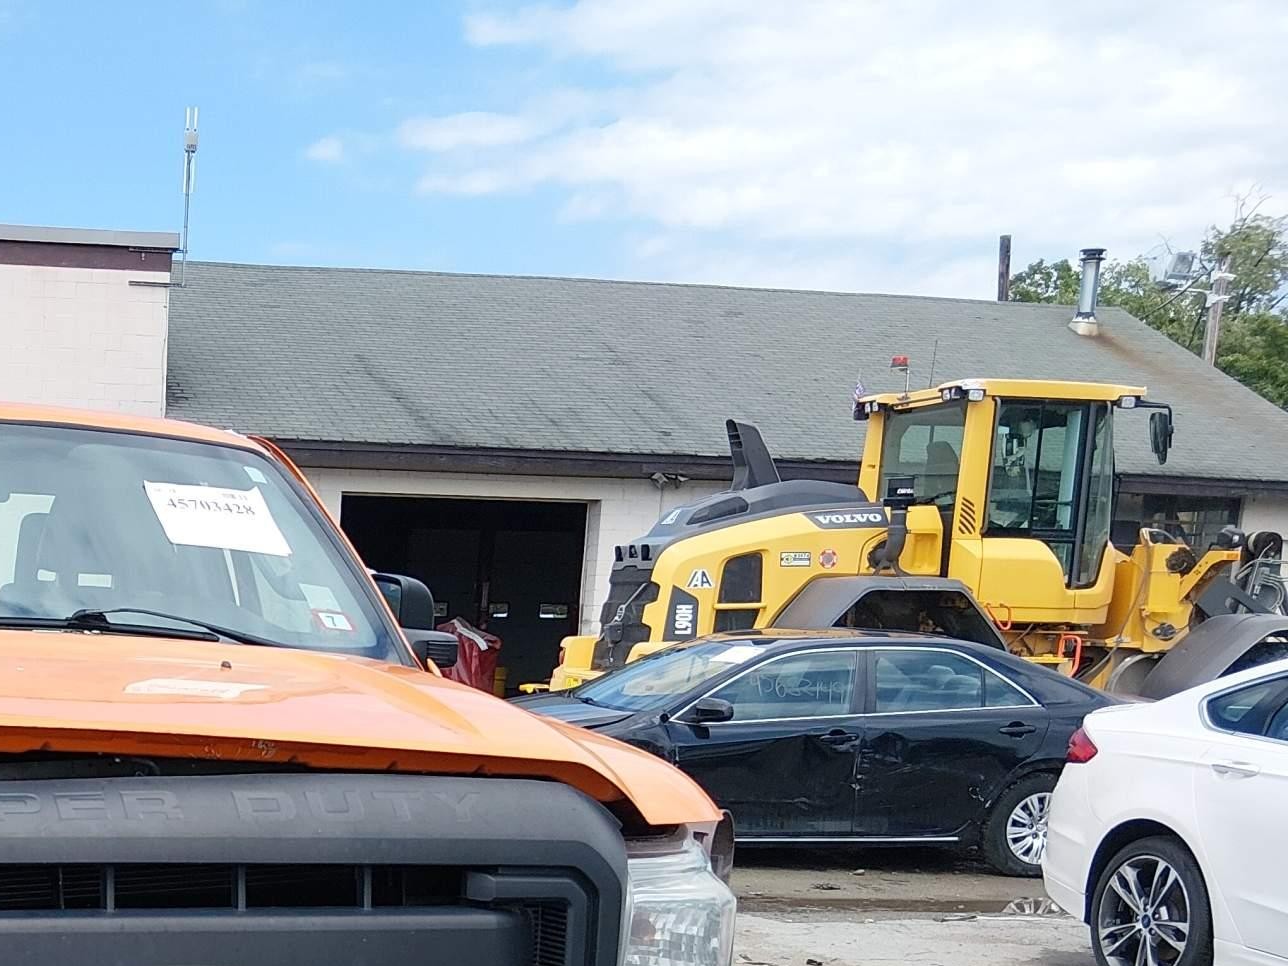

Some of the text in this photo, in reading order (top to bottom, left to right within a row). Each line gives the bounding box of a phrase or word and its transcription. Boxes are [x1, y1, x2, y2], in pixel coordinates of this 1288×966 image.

[167, 497, 256, 516] 45703428
[815, 511, 883, 525] VOLVO
[324, 615, 337, 627] 7
[674, 604, 694, 635] L90H
[230, 789, 482, 823] DUTY
